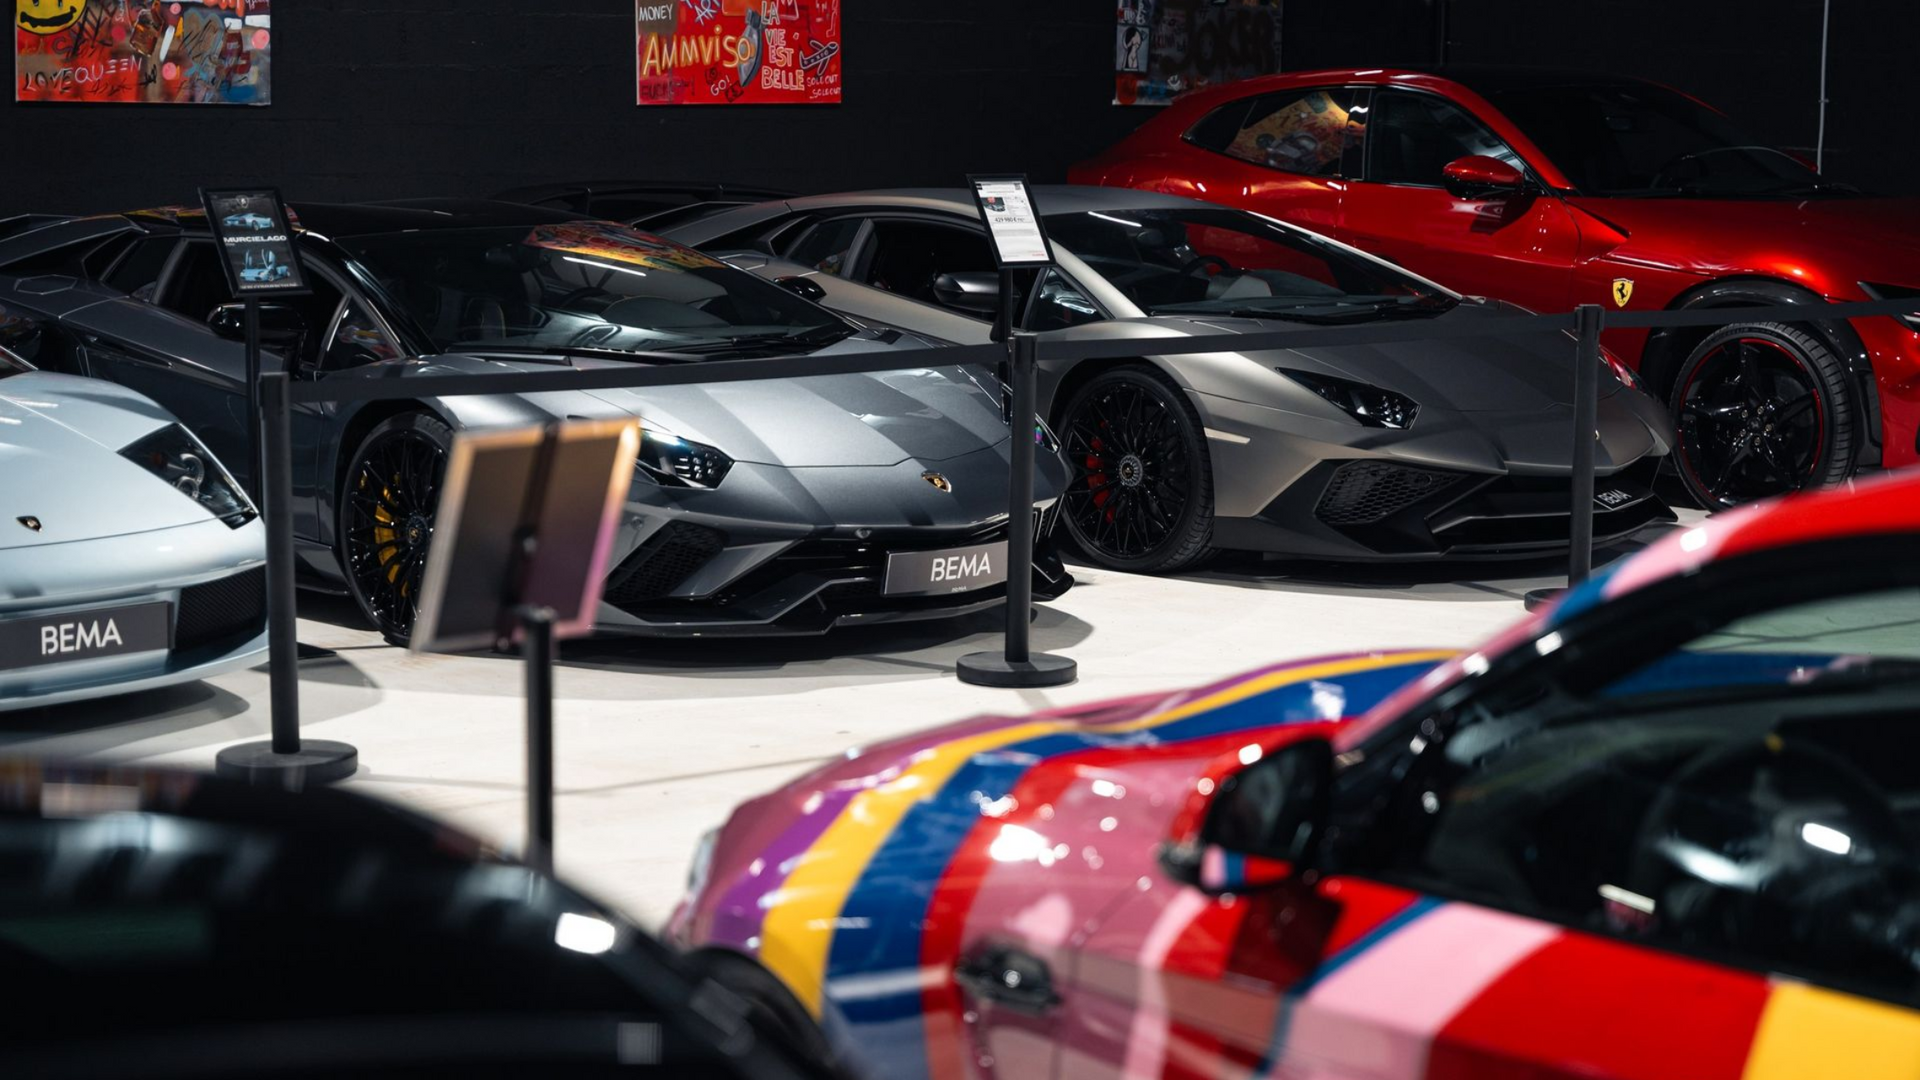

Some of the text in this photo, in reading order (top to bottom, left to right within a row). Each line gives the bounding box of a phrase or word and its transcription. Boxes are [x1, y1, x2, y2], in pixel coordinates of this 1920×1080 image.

[639, 4, 673, 21] MONEY
[760, 0, 781, 25] LA
[765, 29, 787, 47] VIE
[769, 46, 794, 67] EST
[761, 66, 805, 91] BELLE
[223, 235, 287, 243] MURCIELAGO
[930, 552, 991, 582] BEMA
[41, 618, 123, 655] BEMA
